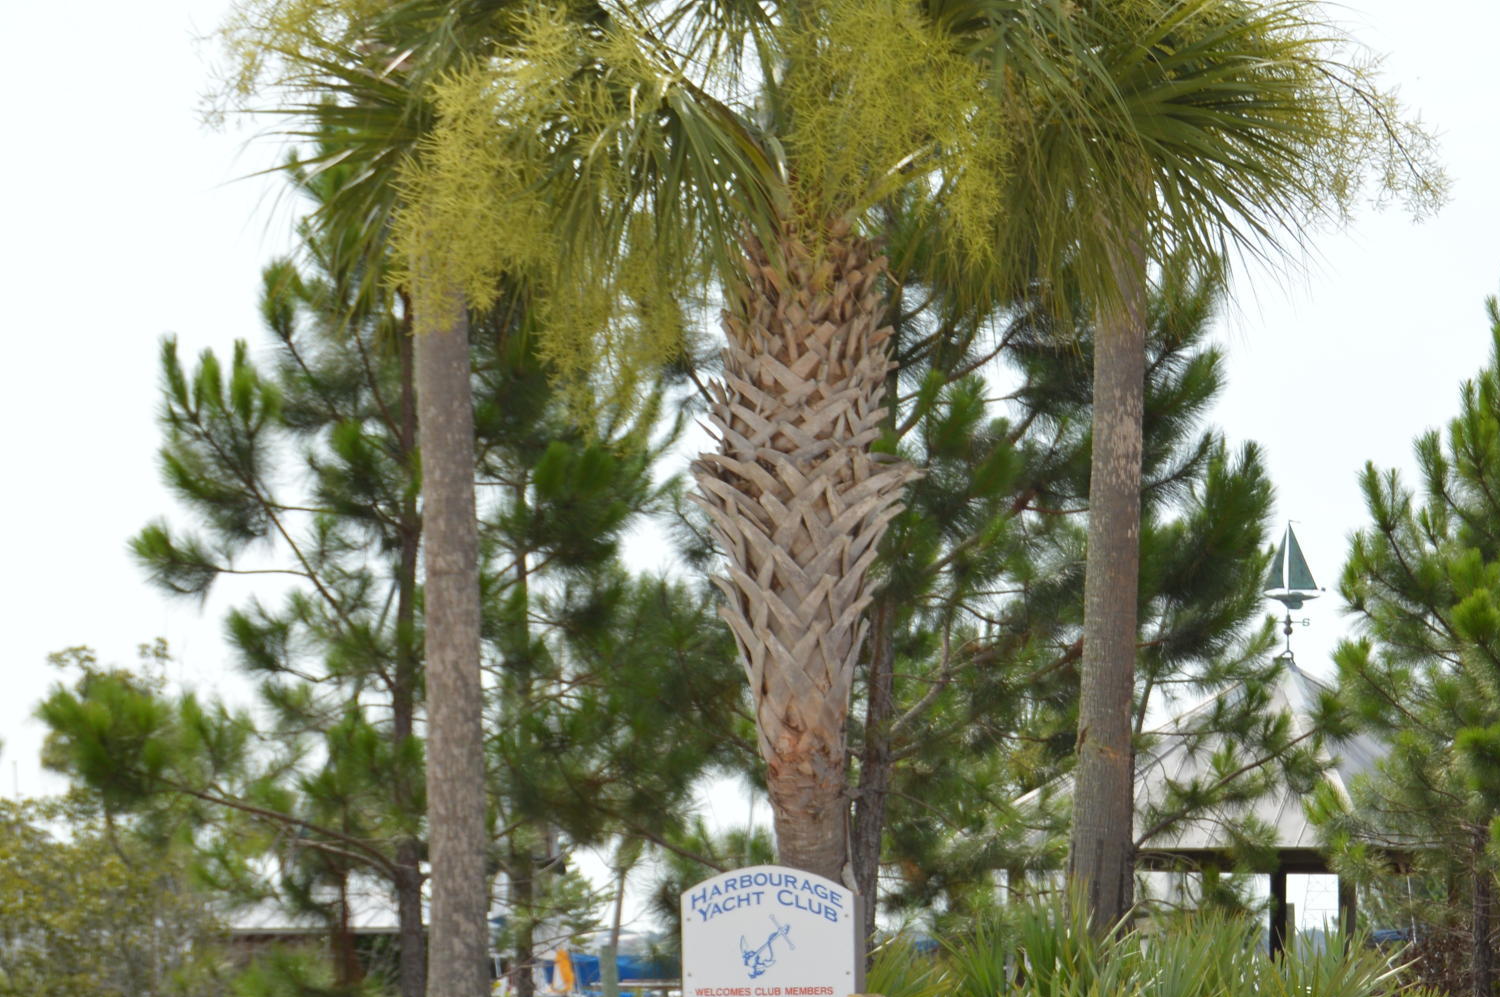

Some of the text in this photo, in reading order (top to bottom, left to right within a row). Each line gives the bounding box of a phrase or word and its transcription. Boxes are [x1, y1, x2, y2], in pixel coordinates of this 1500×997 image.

[691, 872, 842, 910] HARBOURAGE
[698, 889, 838, 923] YACHT CLUB
[695, 986, 834, 997] WELCOMES CLUB MEMBERS
